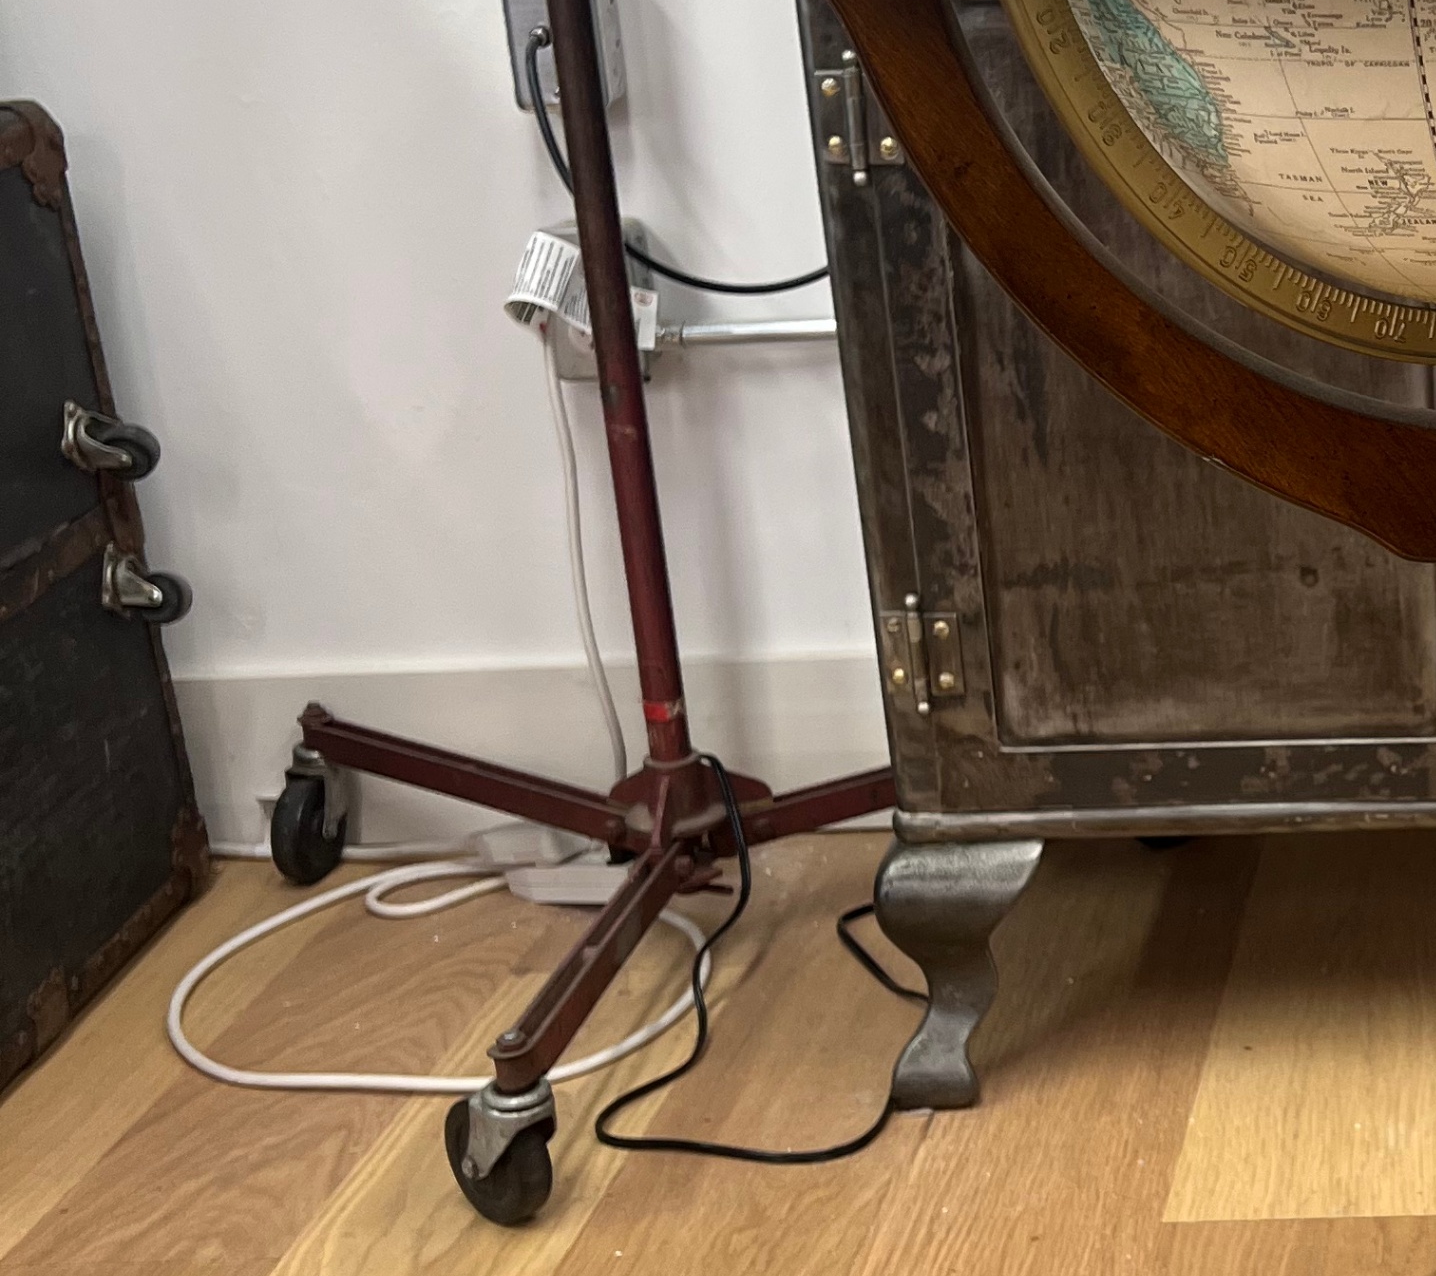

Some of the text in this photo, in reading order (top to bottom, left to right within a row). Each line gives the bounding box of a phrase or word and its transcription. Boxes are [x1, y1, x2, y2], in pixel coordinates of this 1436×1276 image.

[1278, 173, 1323, 184] TASMAN
[1302, 194, 1324, 204] SEA
[1220, 245, 1257, 283] 50
